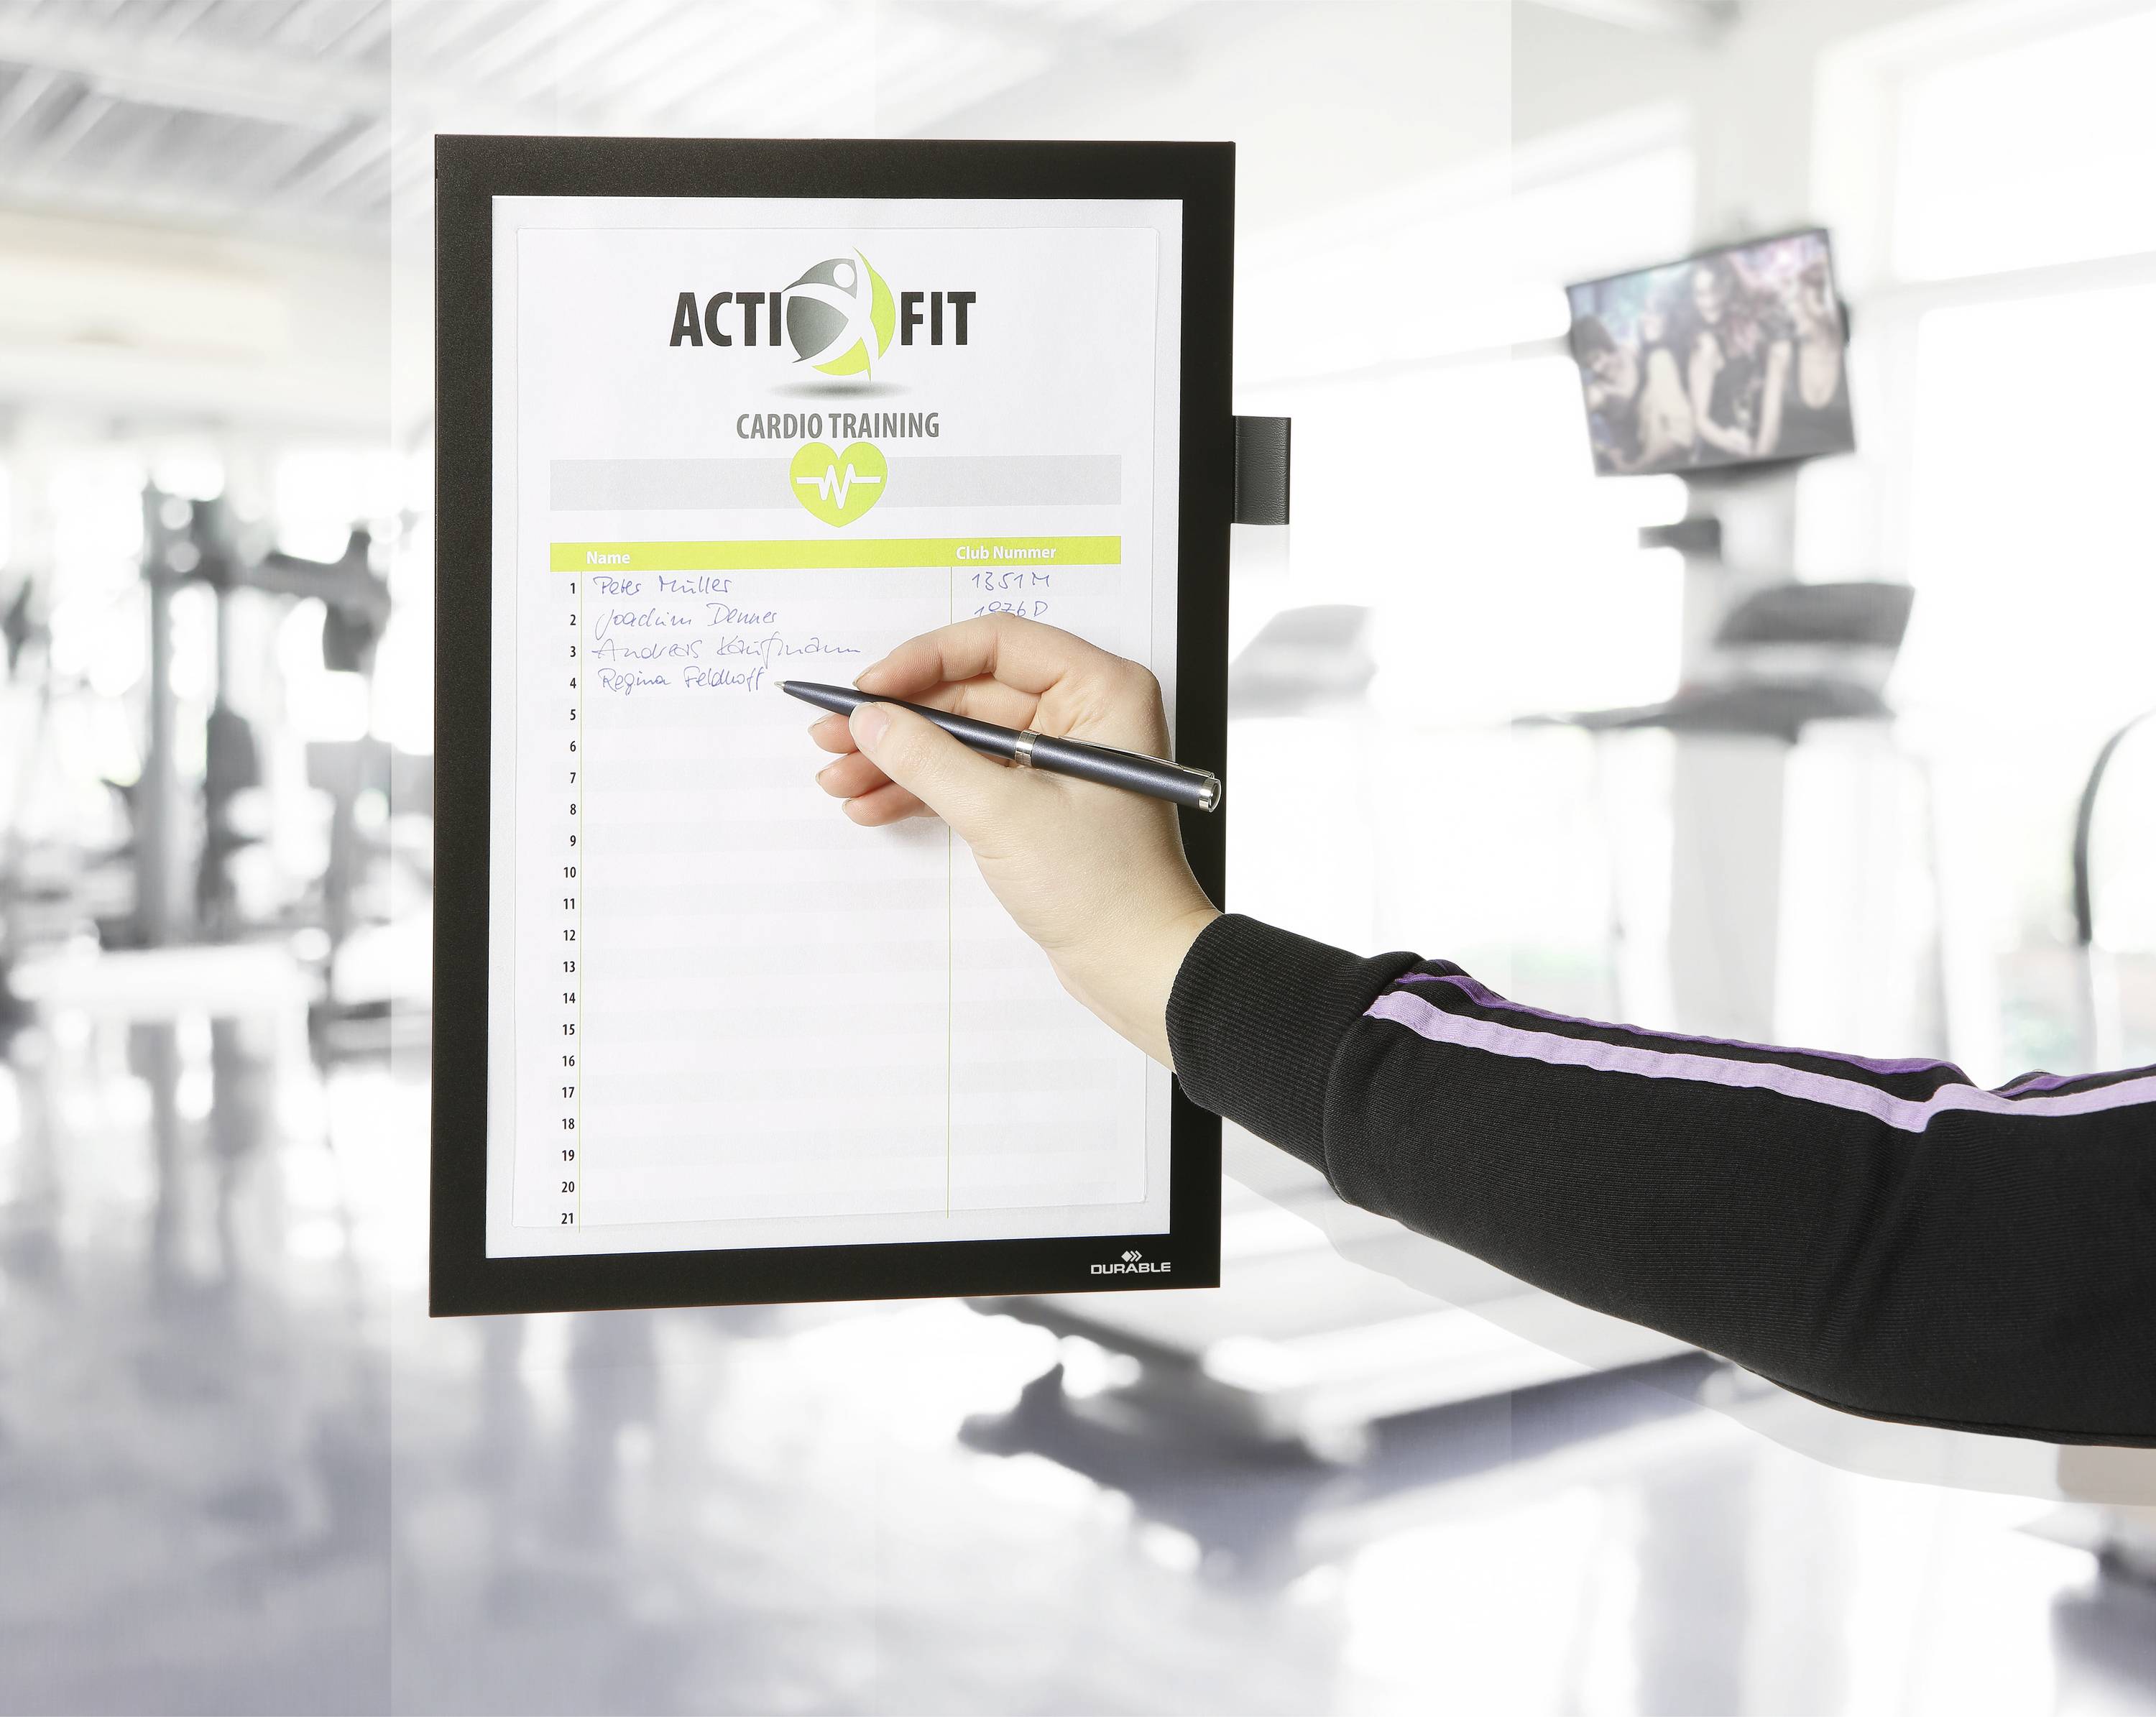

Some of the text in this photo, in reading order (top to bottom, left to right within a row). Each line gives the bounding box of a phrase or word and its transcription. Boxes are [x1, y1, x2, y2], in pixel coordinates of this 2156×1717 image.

[669, 290, 977, 346] ACTI FIT
[736, 412, 939, 439] CARDIO TRAINING
[586, 551, 630, 565] Name
[956, 546, 1056, 560] Club Nummer
[569, 581, 576, 595] 1
[593, 575, 732, 596] Peter Müller
[569, 613, 577, 627] 2
[595, 607, 692, 640] Joachim
[569, 645, 577, 658] 3
[591, 631, 862, 669] Andreas Kaufmann
[568, 676, 578, 690] 4
[597, 666, 765, 696] Regina Feldhoff
[569, 708, 577, 722] 5
[568, 740, 577, 753] 6
[569, 771, 577, 785] 7
[569, 802, 577, 816] 8
[569, 834, 577, 847] 9
[563, 865, 577, 879] 10
[562, 897, 576, 911] 11
[562, 929, 576, 942] 12
[562, 959, 576, 974] 13
[562, 991, 577, 1005] 14
[561, 1023, 576, 1036] 15
[561, 1054, 576, 1068] 16
[561, 1085, 576, 1100] 17
[561, 1117, 576, 1131] 18
[561, 1148, 576, 1162] 19
[561, 1180, 576, 1194] 20
[560, 1212, 574, 1225] 21
[1090, 1261, 1171, 1275] DURABLE
